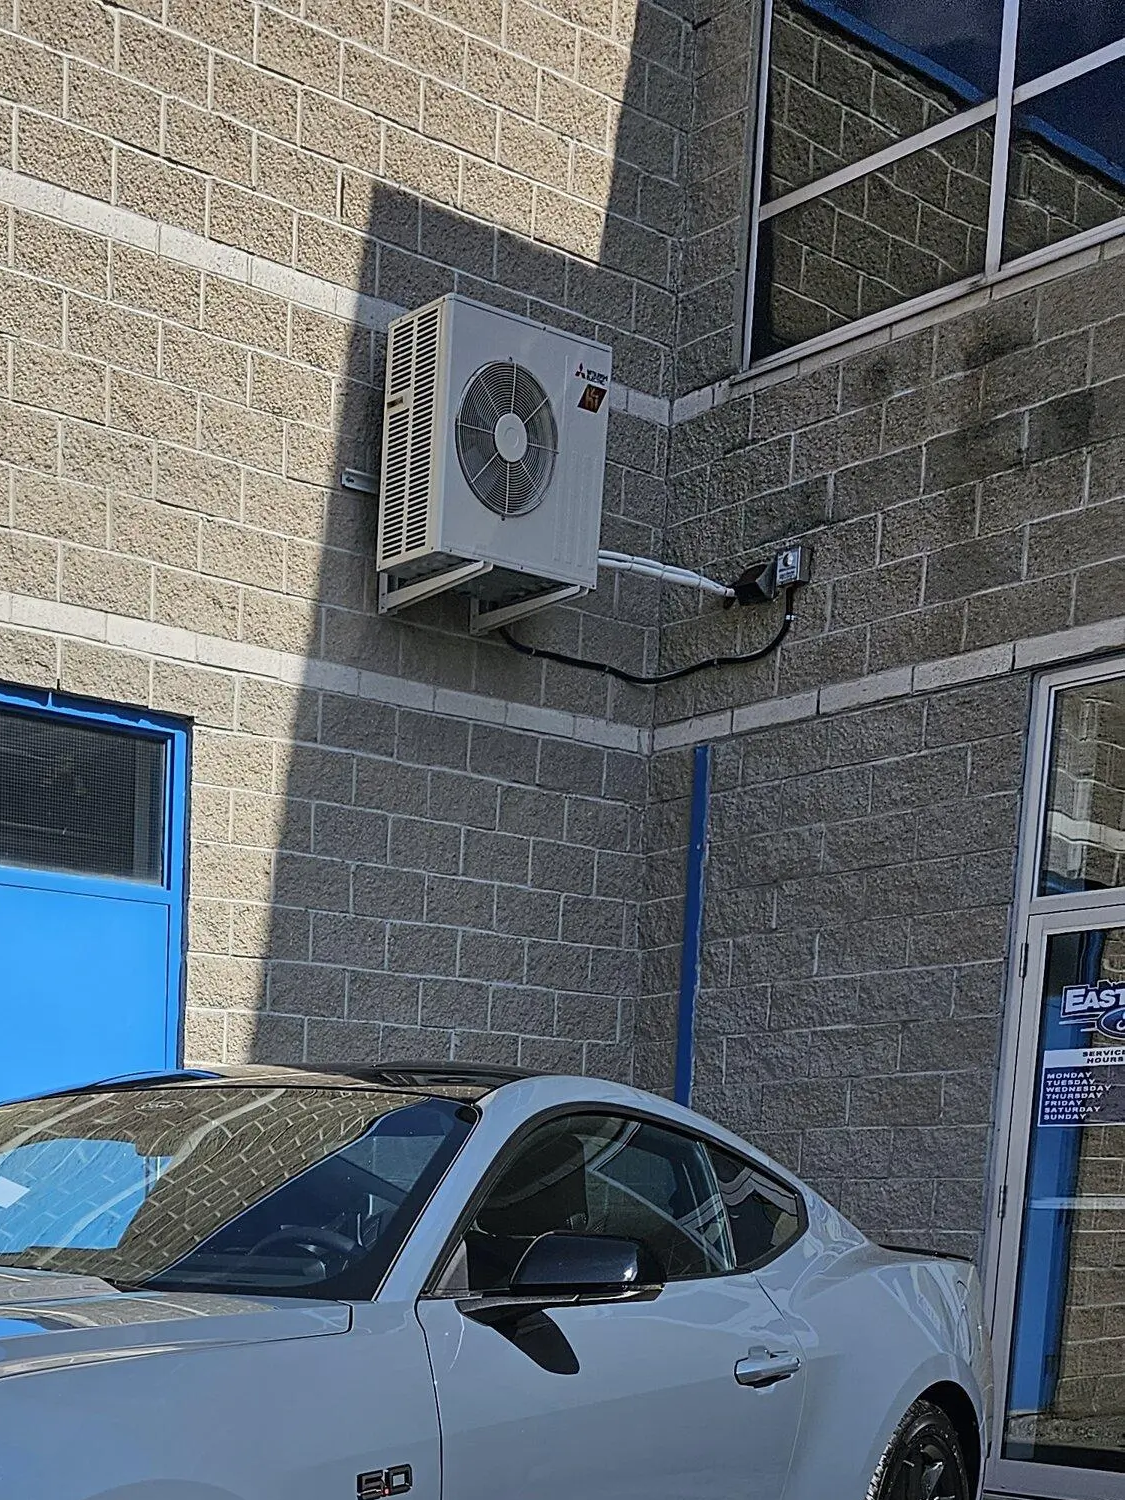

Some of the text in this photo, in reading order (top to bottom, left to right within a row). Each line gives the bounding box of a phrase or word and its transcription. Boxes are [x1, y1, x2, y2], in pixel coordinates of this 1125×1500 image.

[1086, 1056, 1124, 1064] HOURS
[1046, 1071, 1092, 1079] MONDAY
[1045, 1084, 1112, 1093] WEDNESDAY
[1045, 1092, 1103, 1100] THURSDAY
[1043, 1113, 1087, 1121] SUNDAY
